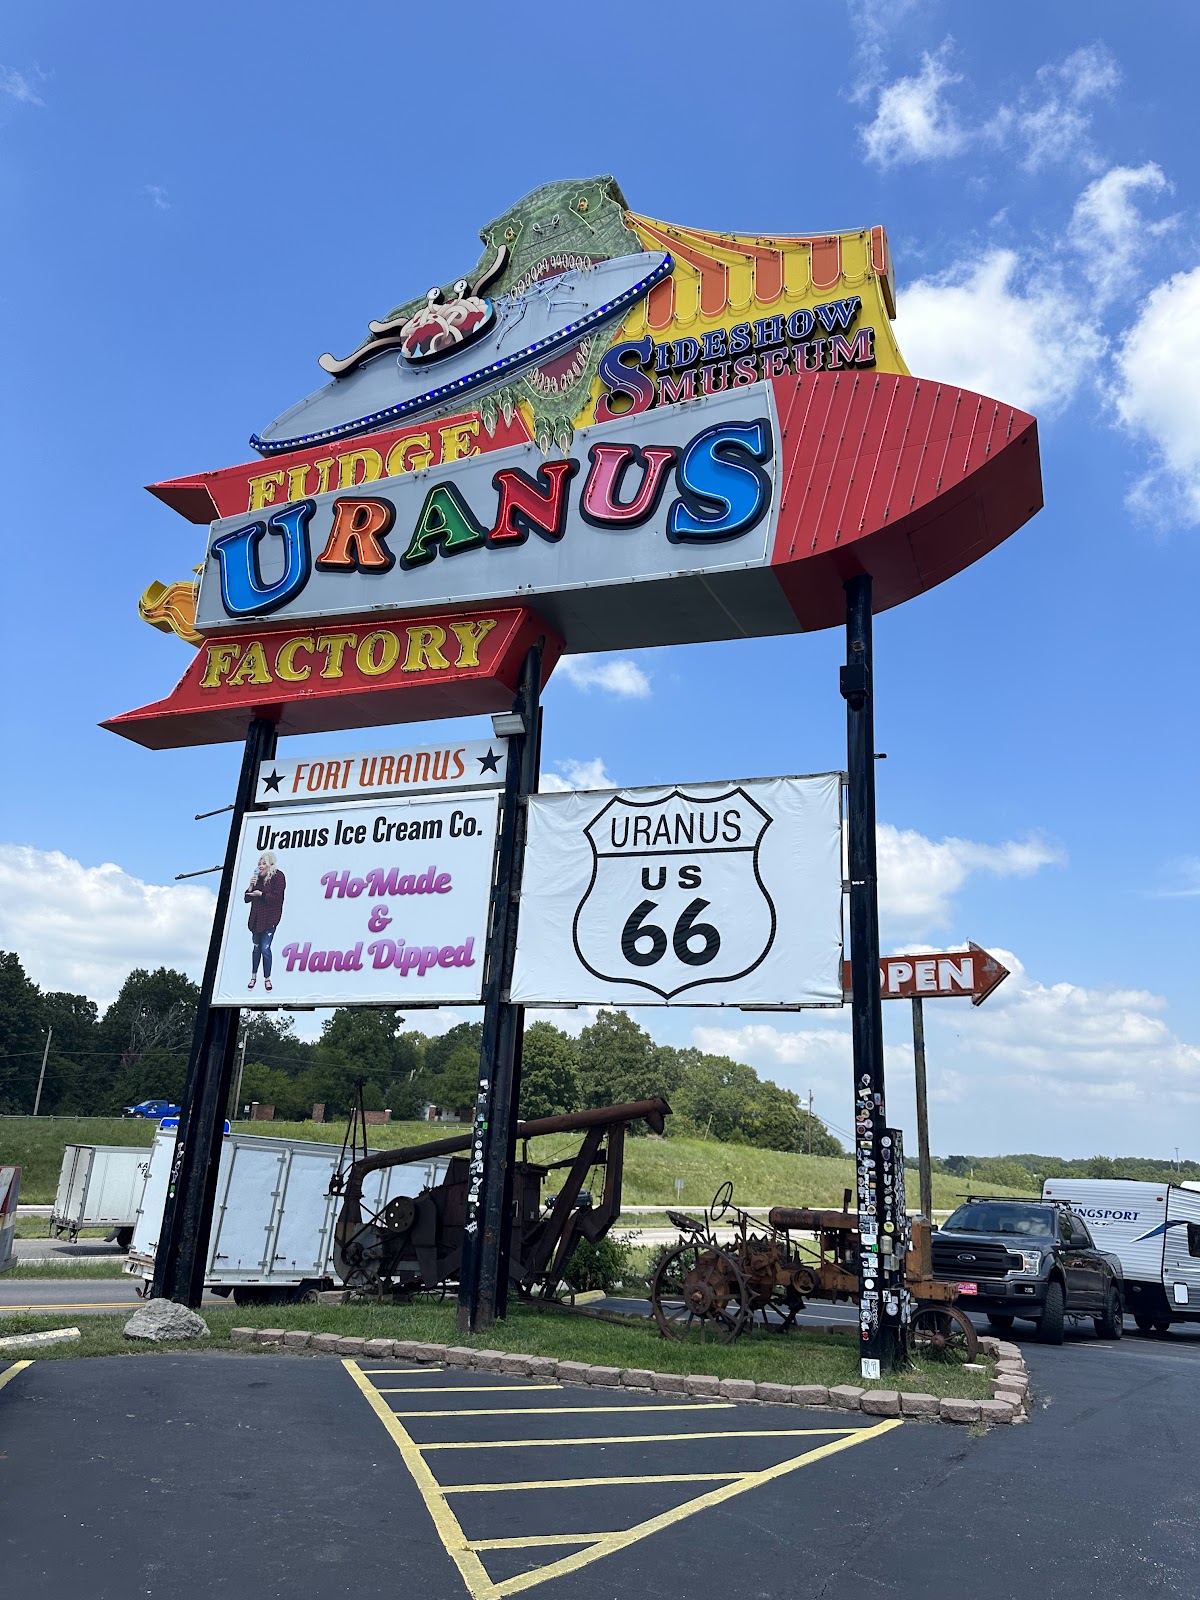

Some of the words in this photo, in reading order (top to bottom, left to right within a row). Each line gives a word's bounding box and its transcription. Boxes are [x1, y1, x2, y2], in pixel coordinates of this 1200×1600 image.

[594, 296, 862, 423] SIDESHOW
[655, 327, 876, 408] MUSEUM
[247, 418, 482, 511] FUDGE
[211, 417, 773, 618] URANUS
[200, 616, 498, 689] FACTORY
[291, 758, 354, 793] FORT
[359, 748, 466, 787] URANUS
[256, 824, 330, 851] Uranus
[334, 819, 366, 845] Ice
[372, 816, 443, 843] Cream
[449, 810, 483, 838] Co.
[611, 809, 742, 848] URANUS
[320, 865, 452, 899] HoMade
[641, 865, 702, 891] US
[367, 904, 392, 933] &
[621, 897, 721, 967] 66
[281, 941, 364, 972] Hand
[367, 936, 476, 977] Dipped
[878, 956, 974, 994] PEN
[1070, 1208, 1140, 1220] INGSPORT
